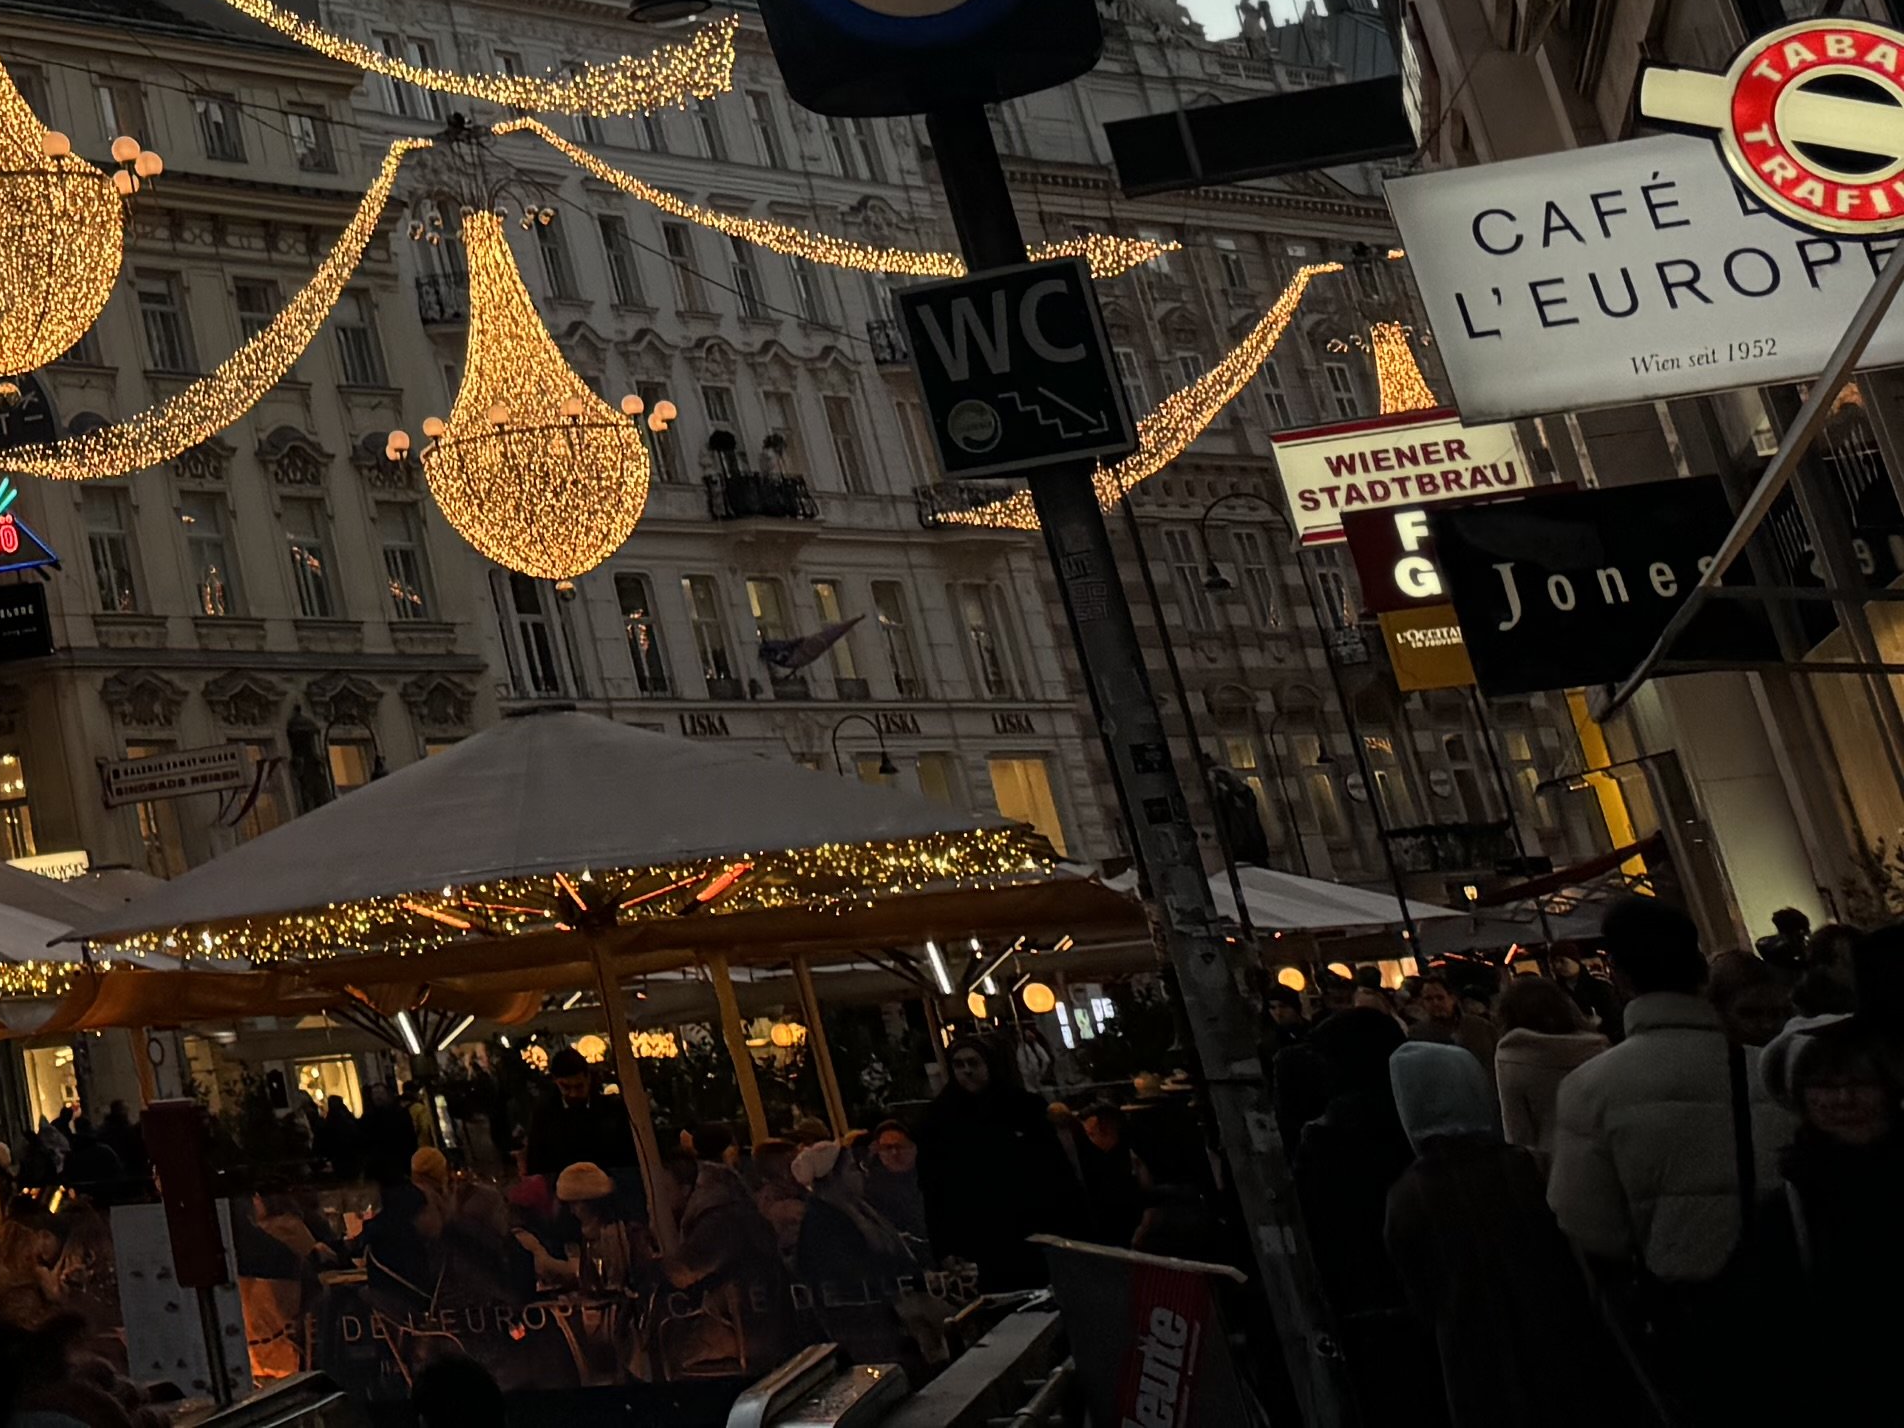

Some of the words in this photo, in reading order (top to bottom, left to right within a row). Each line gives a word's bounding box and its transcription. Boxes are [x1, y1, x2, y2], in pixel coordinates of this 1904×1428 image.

[1752, 33, 1904, 84] TABA
[1471, 171, 1691, 257] CAFÉ
[915, 278, 1087, 383] WC
[1631, 352, 1681, 376] Wien
[1688, 346, 1719, 366] seit
[1728, 337, 1778, 363] 1952
[1323, 438, 1471, 479] WIENER
[1298, 461, 1519, 514] STADTBRÄU
